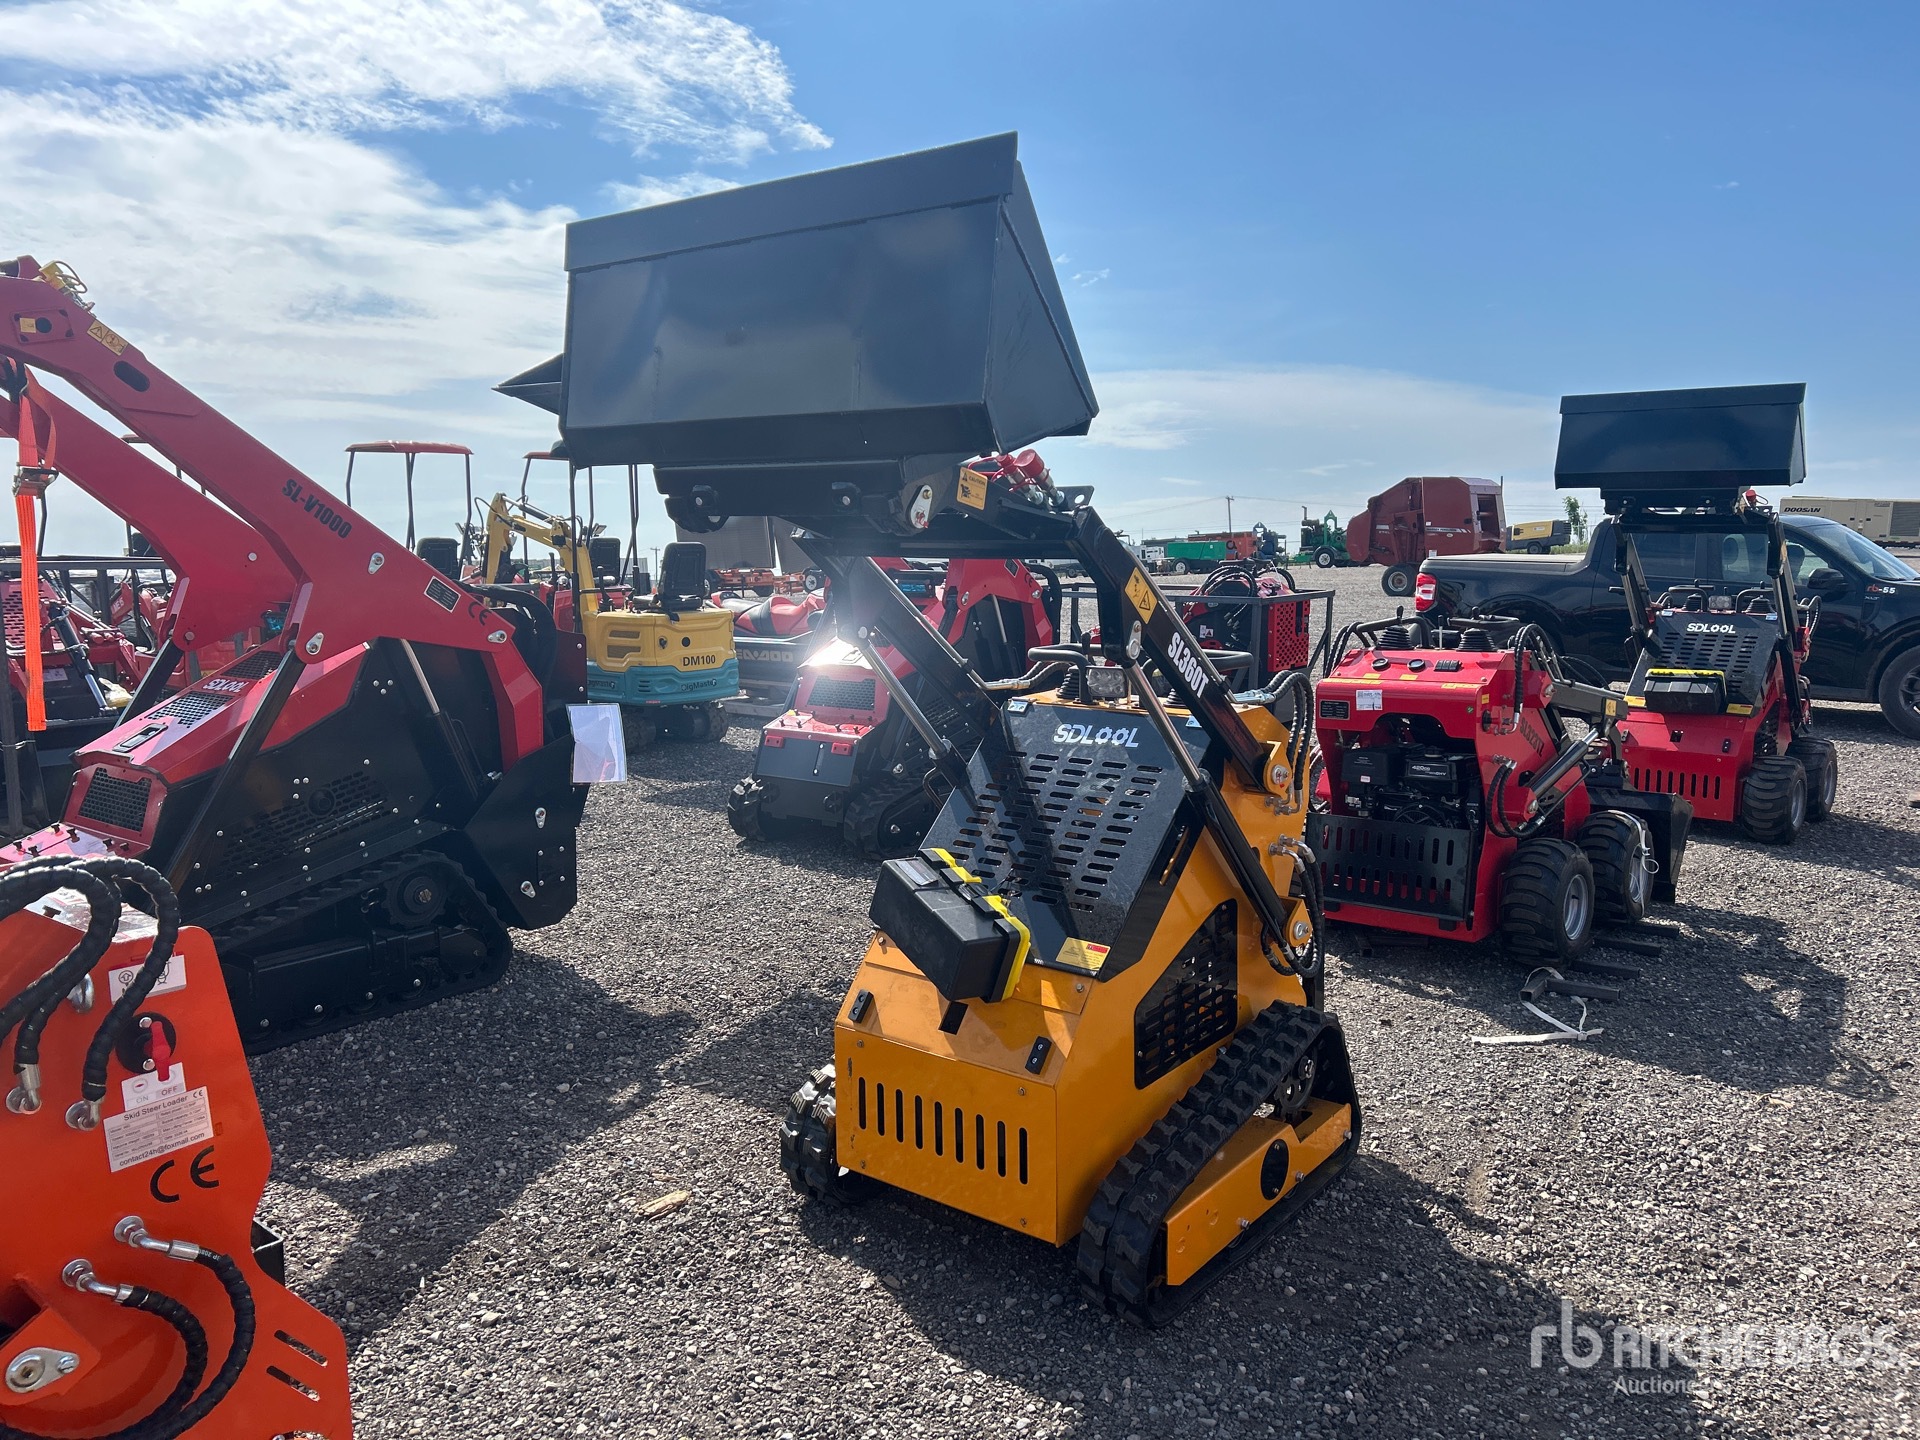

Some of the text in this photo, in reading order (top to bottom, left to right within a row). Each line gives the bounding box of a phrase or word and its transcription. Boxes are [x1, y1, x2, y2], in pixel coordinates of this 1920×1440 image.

[282, 479, 352, 538] SL-V1000
[1687, 623, 1736, 634] SDLOOL
[682, 655, 716, 667] DM100
[1168, 631, 1209, 698] SL360T
[1053, 723, 1139, 748] SDLOOL
[136, 1096, 149, 1104] ON
[161, 1086, 178, 1096] OFF
[123, 1111, 140, 1121] Skid
[141, 1104, 161, 1115] Steer
[162, 1095, 188, 1108] Loader
[120, 1132, 205, 1166] contact24h@foxmail.com
